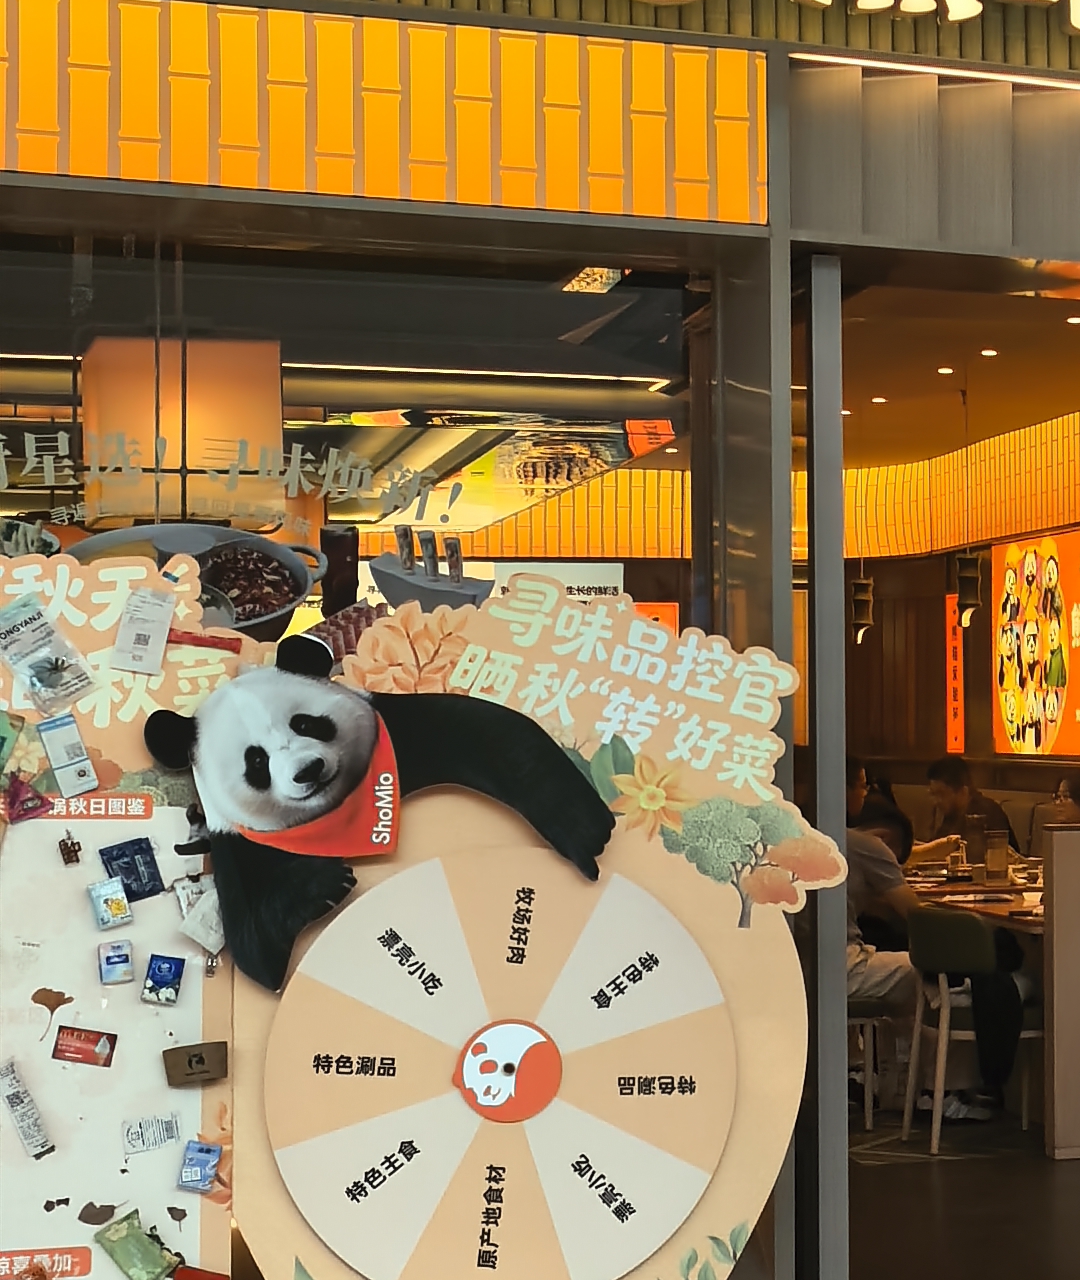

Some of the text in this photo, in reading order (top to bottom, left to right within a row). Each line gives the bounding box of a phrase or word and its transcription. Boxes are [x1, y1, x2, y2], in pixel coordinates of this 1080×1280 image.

[0, 431, 463, 524] 星选！寻味焕新！
[0, 563, 147, 631] 秋天
[488, 579, 795, 724] 寻味品控官
[449, 643, 779, 802] 晒秋“转”好菜
[371, 771, 394, 846] ShoMio
[505, 886, 535, 965] 牧场好肉
[377, 927, 444, 996] 漂亮小吃
[590, 951, 661, 1010] 特色主食
[312, 1054, 397, 1077] 特色涮品
[617, 1075, 697, 1096] 特色涮品
[344, 1139, 421, 1204] 特色主食
[570, 1153, 638, 1224] 漂亮小吃
[476, 1164, 506, 1270] 原产地食材
